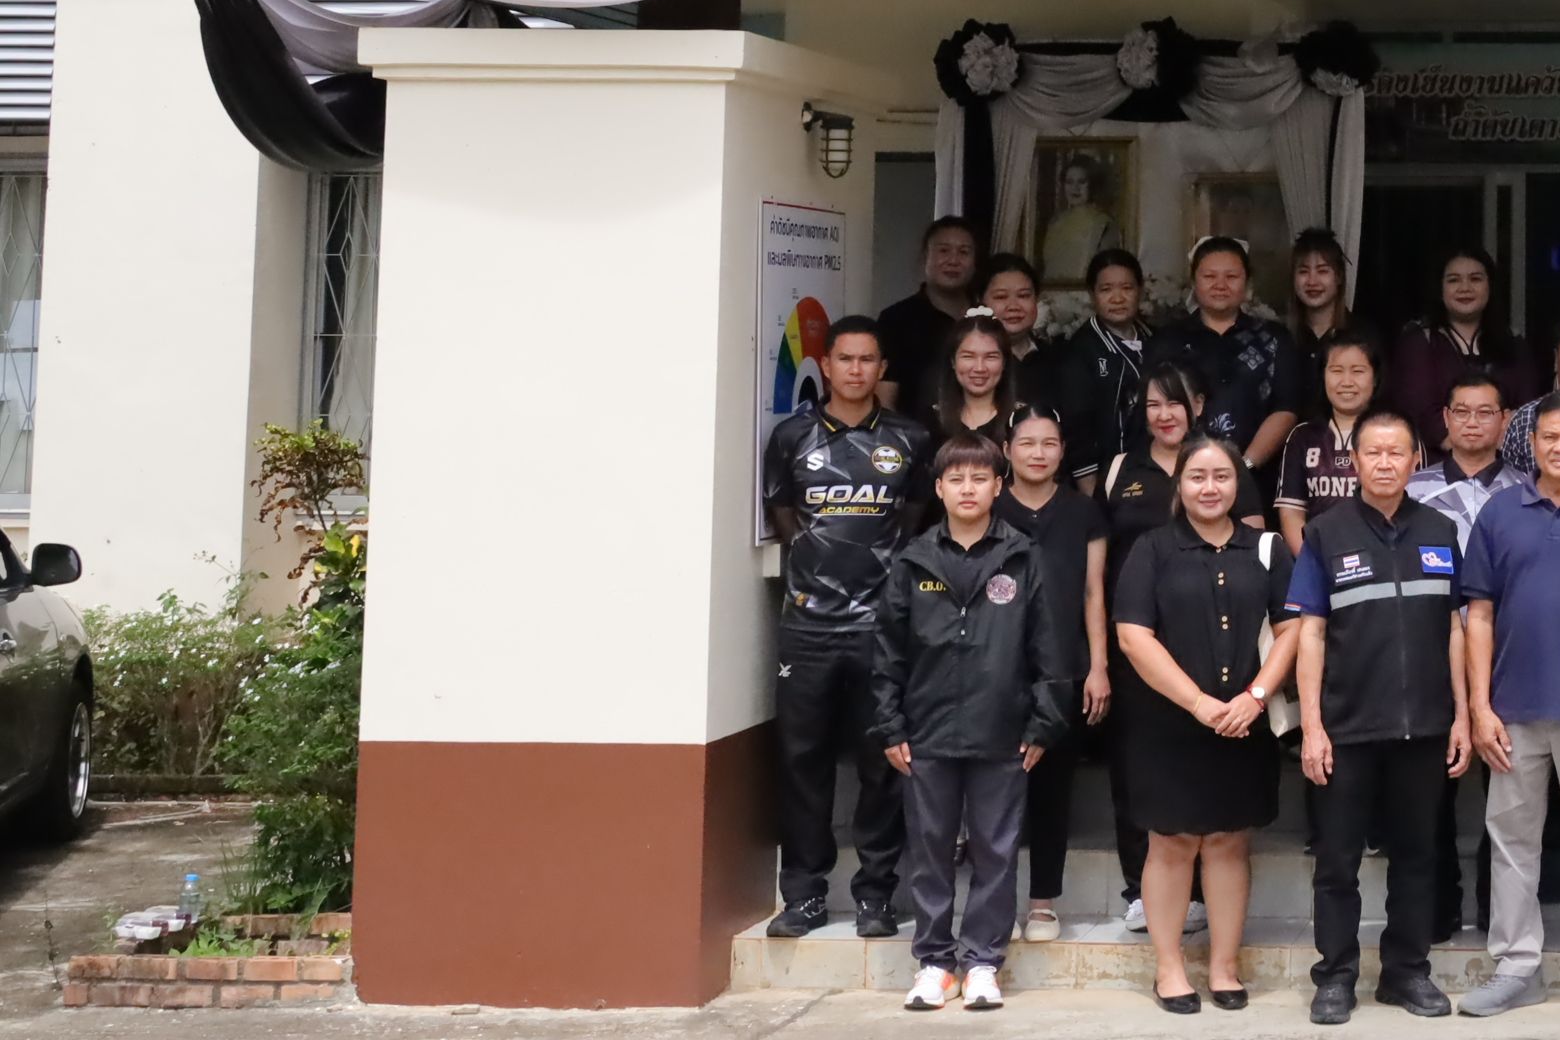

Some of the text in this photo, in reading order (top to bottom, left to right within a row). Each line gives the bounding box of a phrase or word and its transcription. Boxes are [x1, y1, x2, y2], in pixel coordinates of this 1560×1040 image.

[1305, 447, 1321, 468] 8
[805, 484, 894, 504] GOAL
[818, 506, 880, 514] ACADEMY
